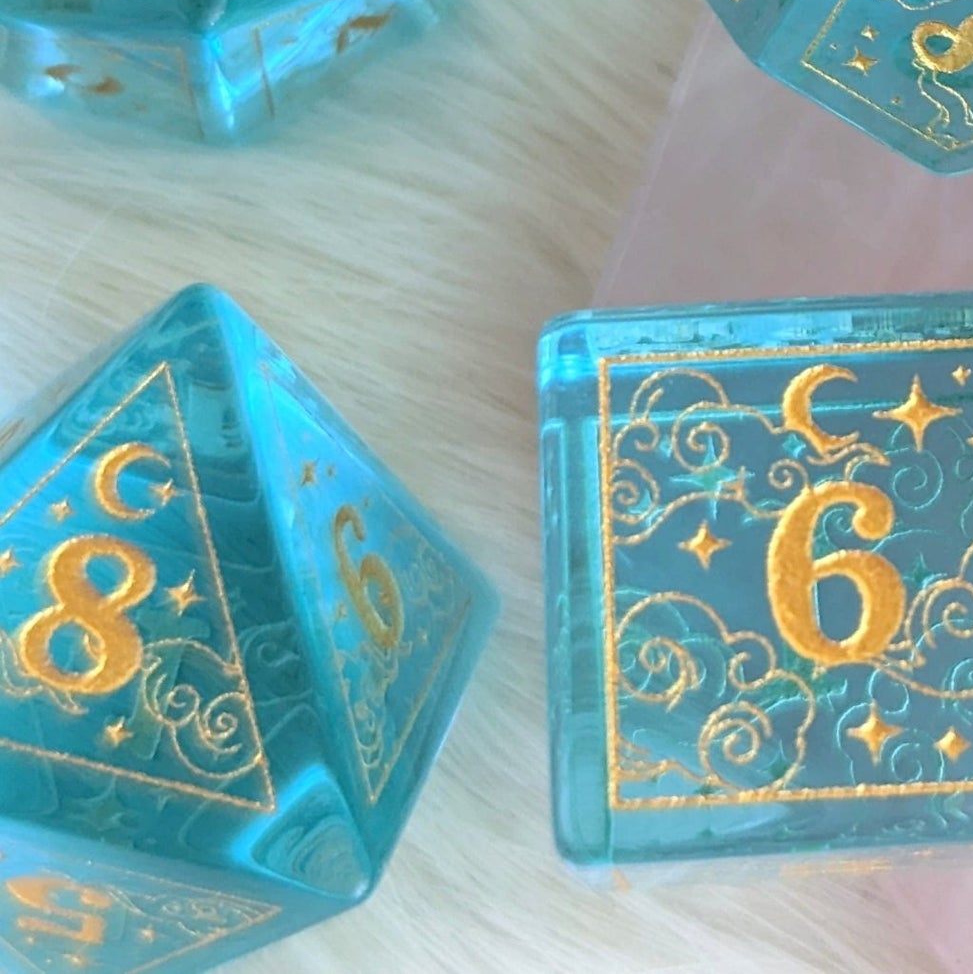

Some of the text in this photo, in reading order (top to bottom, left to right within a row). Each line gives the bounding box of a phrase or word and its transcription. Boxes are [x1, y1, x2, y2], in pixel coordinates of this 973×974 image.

[19, 534, 156, 696] 8
[334, 503, 404, 650] 6
[767, 479, 907, 666] 6
